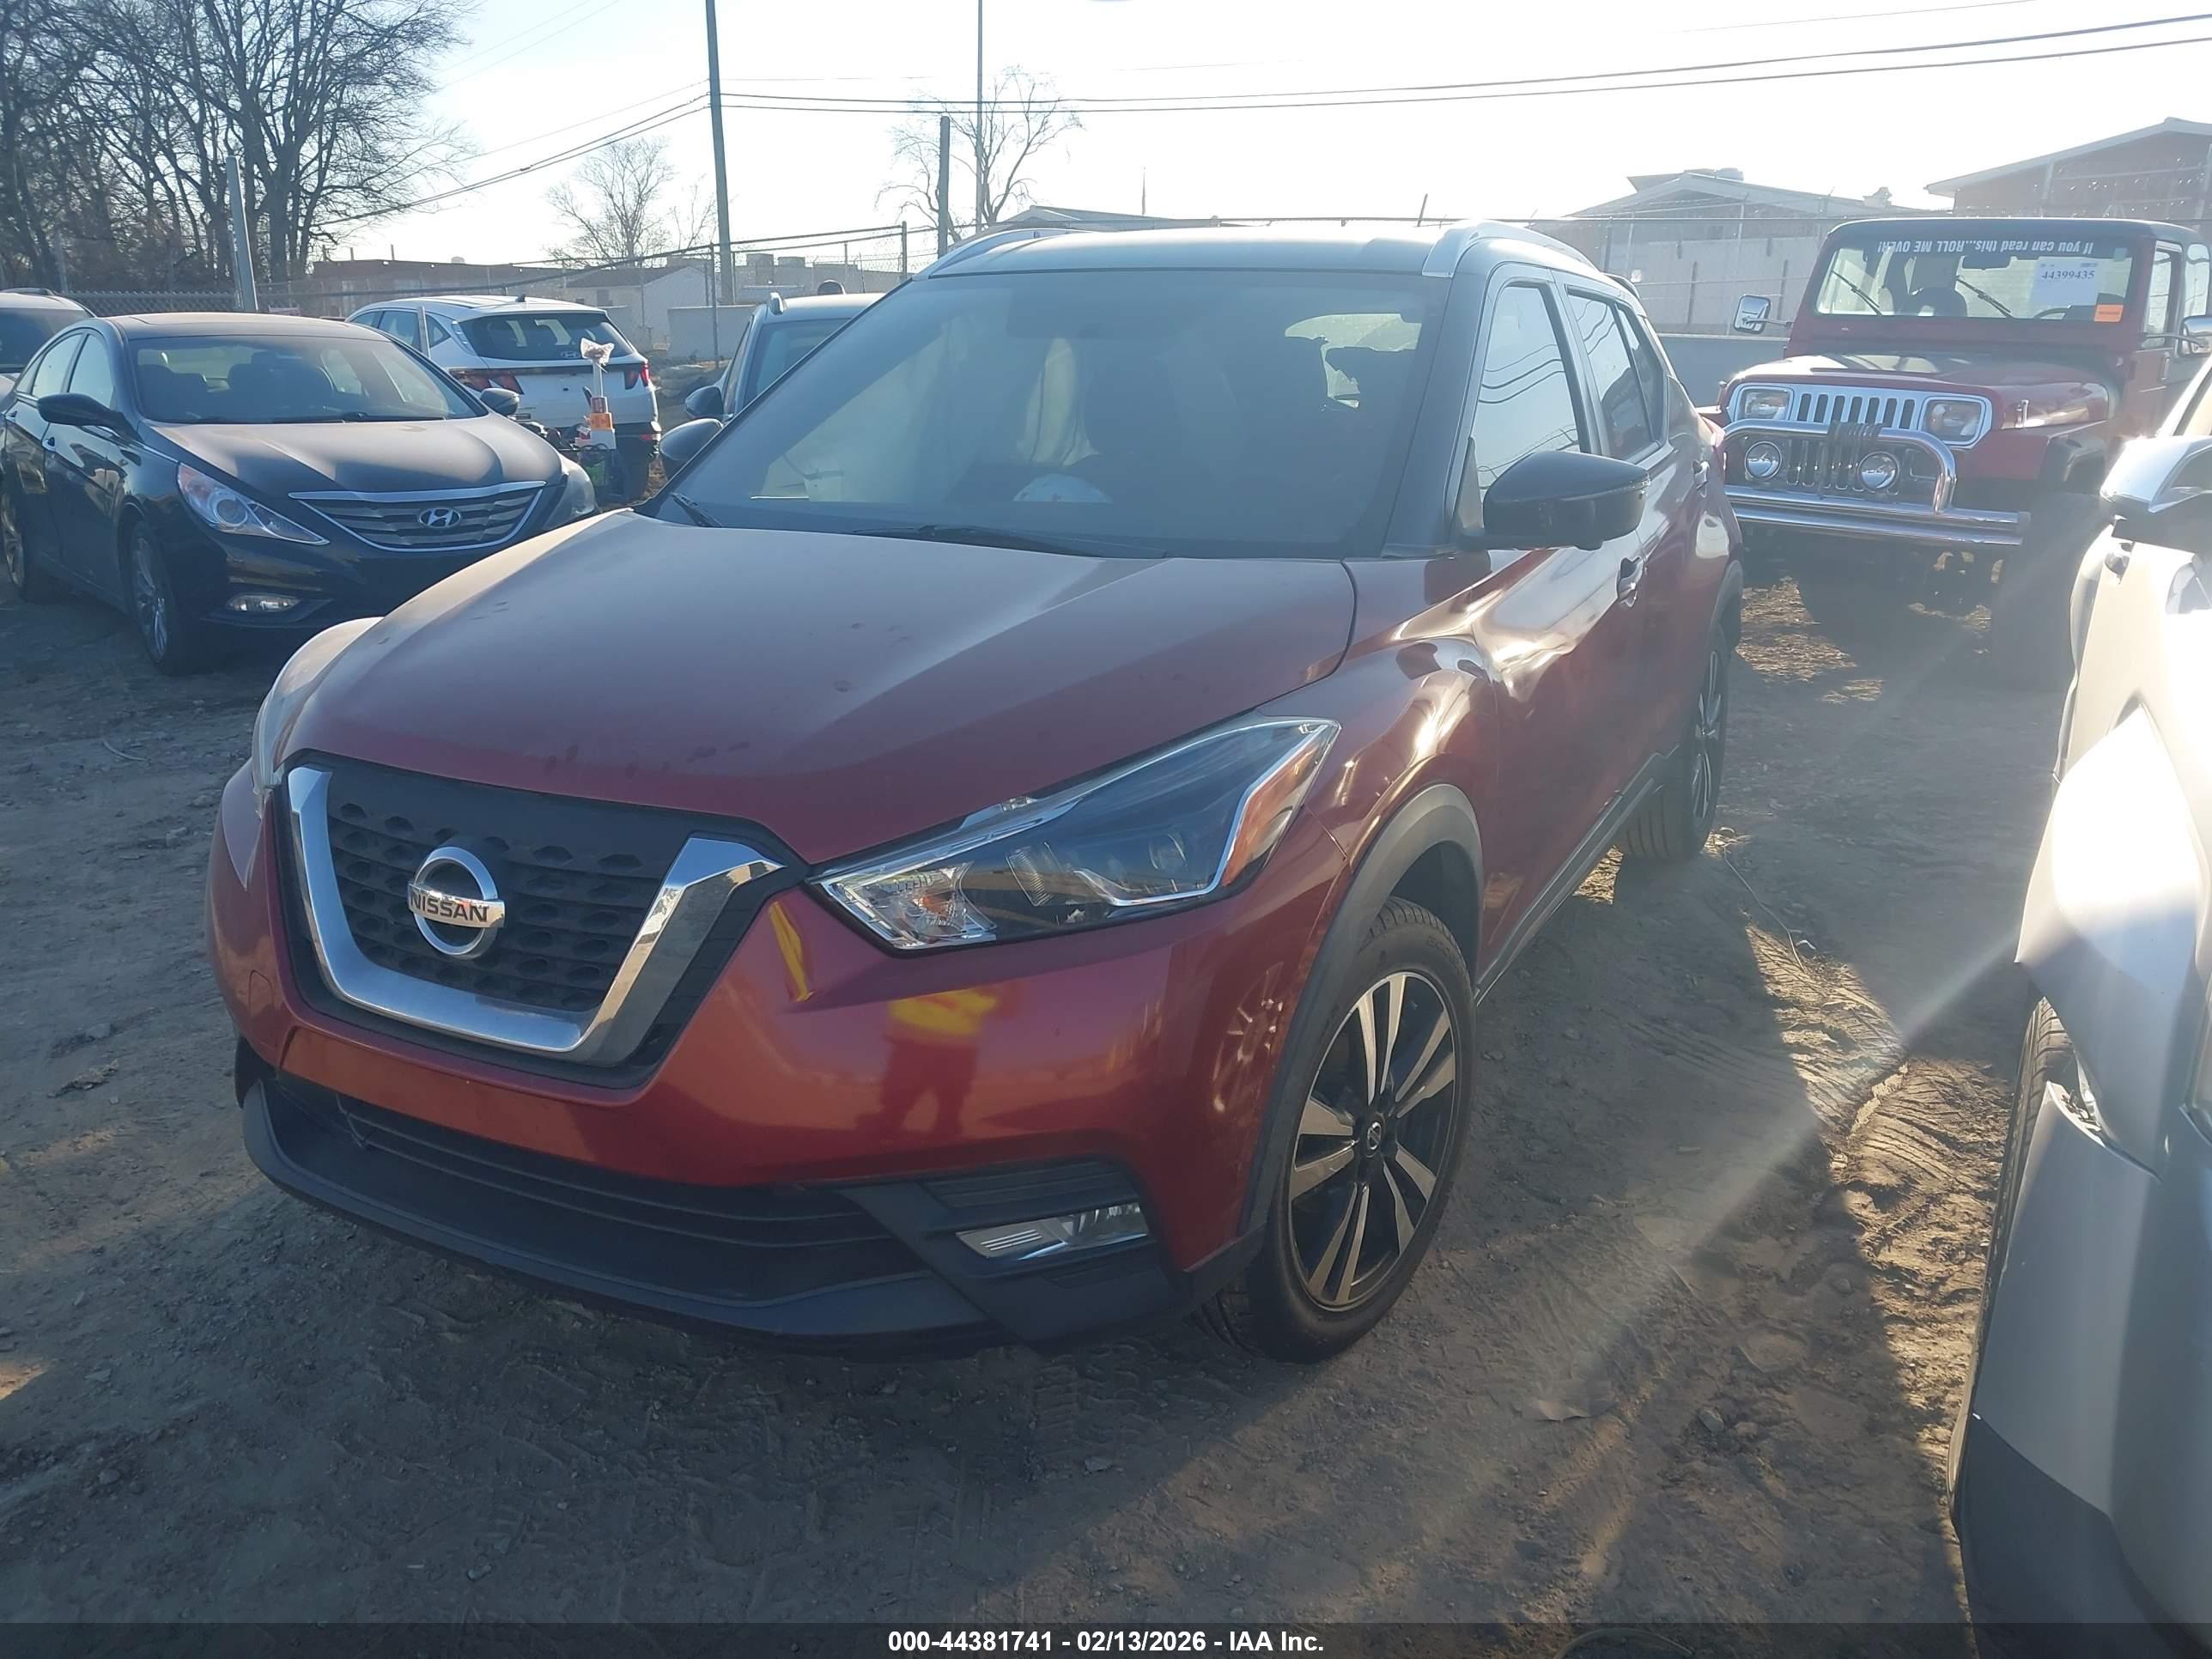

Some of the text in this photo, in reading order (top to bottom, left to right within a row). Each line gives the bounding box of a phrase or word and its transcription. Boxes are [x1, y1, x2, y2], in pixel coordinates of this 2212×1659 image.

[1913, 240, 1933, 252] ME
[2000, 240, 2029, 252] read
[2032, 240, 2055, 252] can
[2057, 240, 2081, 252] you
[2082, 242, 2094, 255] If
[2041, 270, 2095, 280] 44399435
[410, 891, 489, 922] NISSAN
